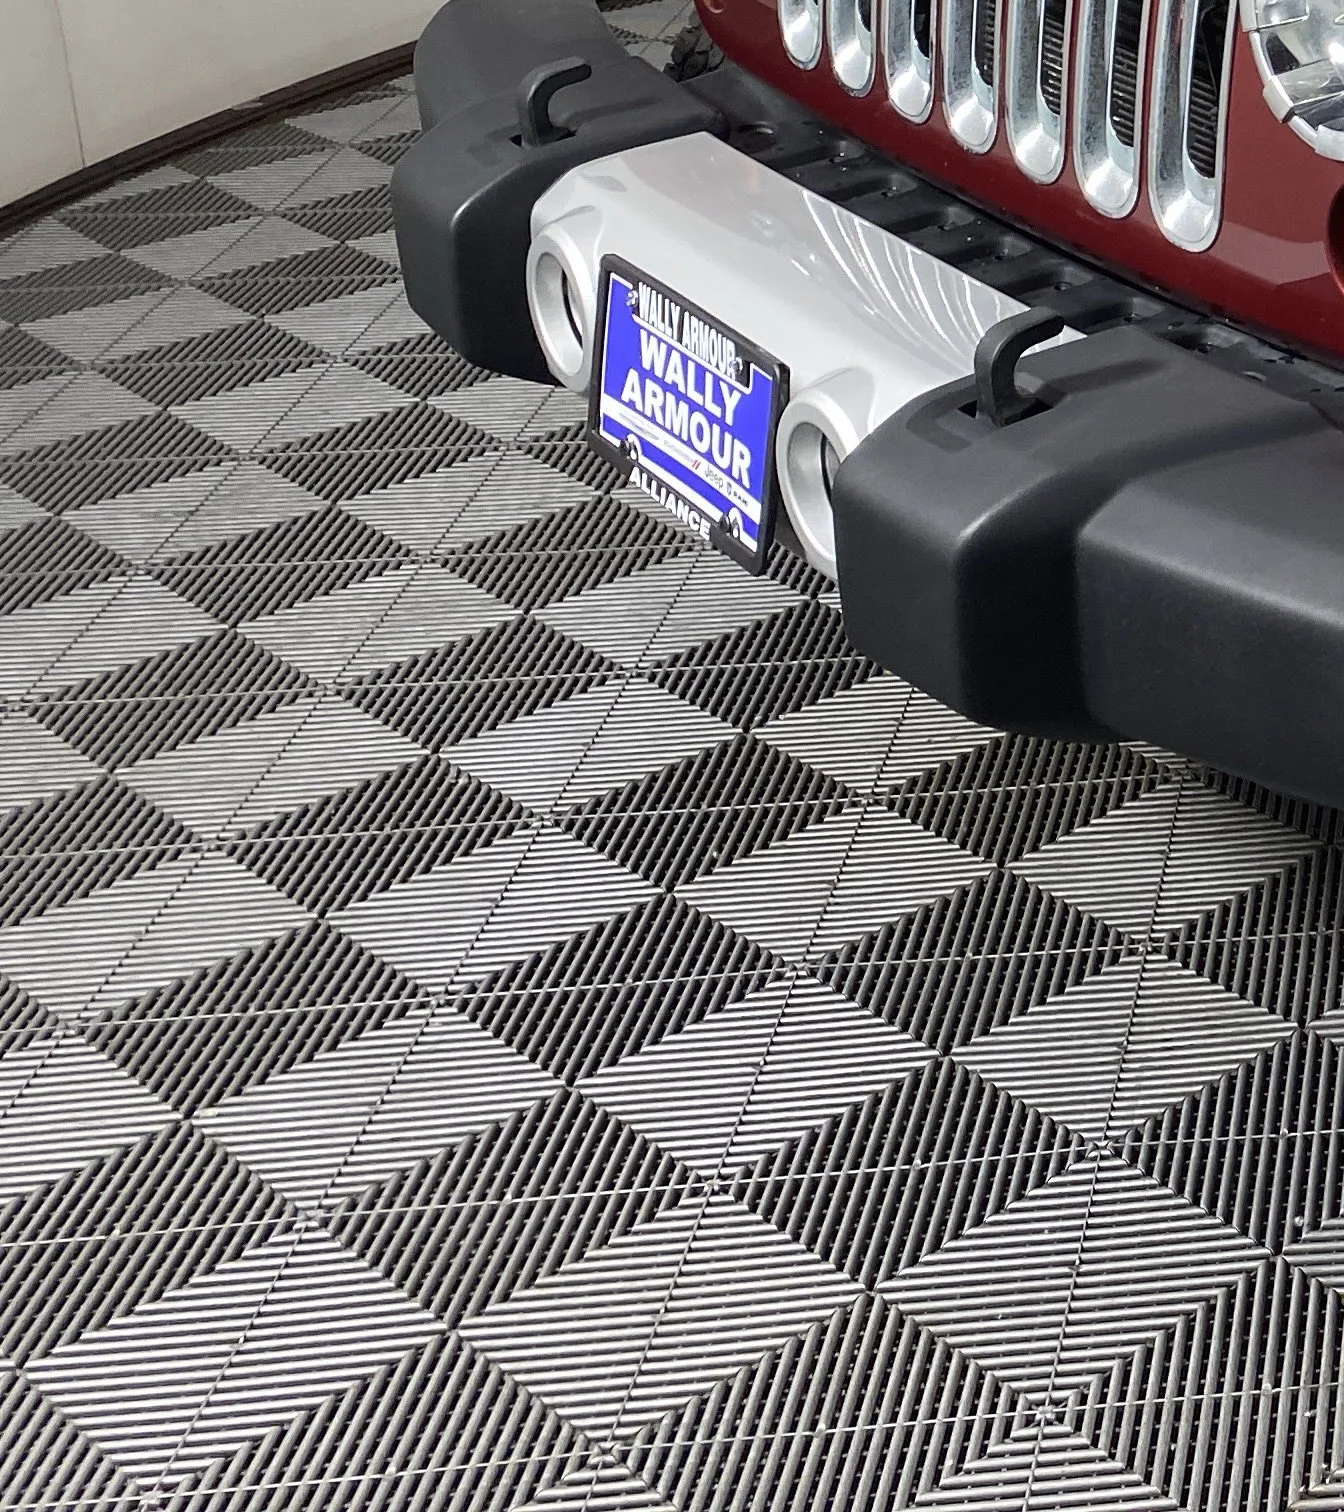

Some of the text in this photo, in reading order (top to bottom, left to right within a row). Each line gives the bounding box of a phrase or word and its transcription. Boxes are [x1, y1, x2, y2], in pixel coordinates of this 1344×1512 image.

[638, 281, 737, 380] WALLY ARMOUR
[640, 328, 742, 427] WALLY
[621, 368, 751, 489] ARMOUR
[629, 466, 711, 541] ALLIANCE
